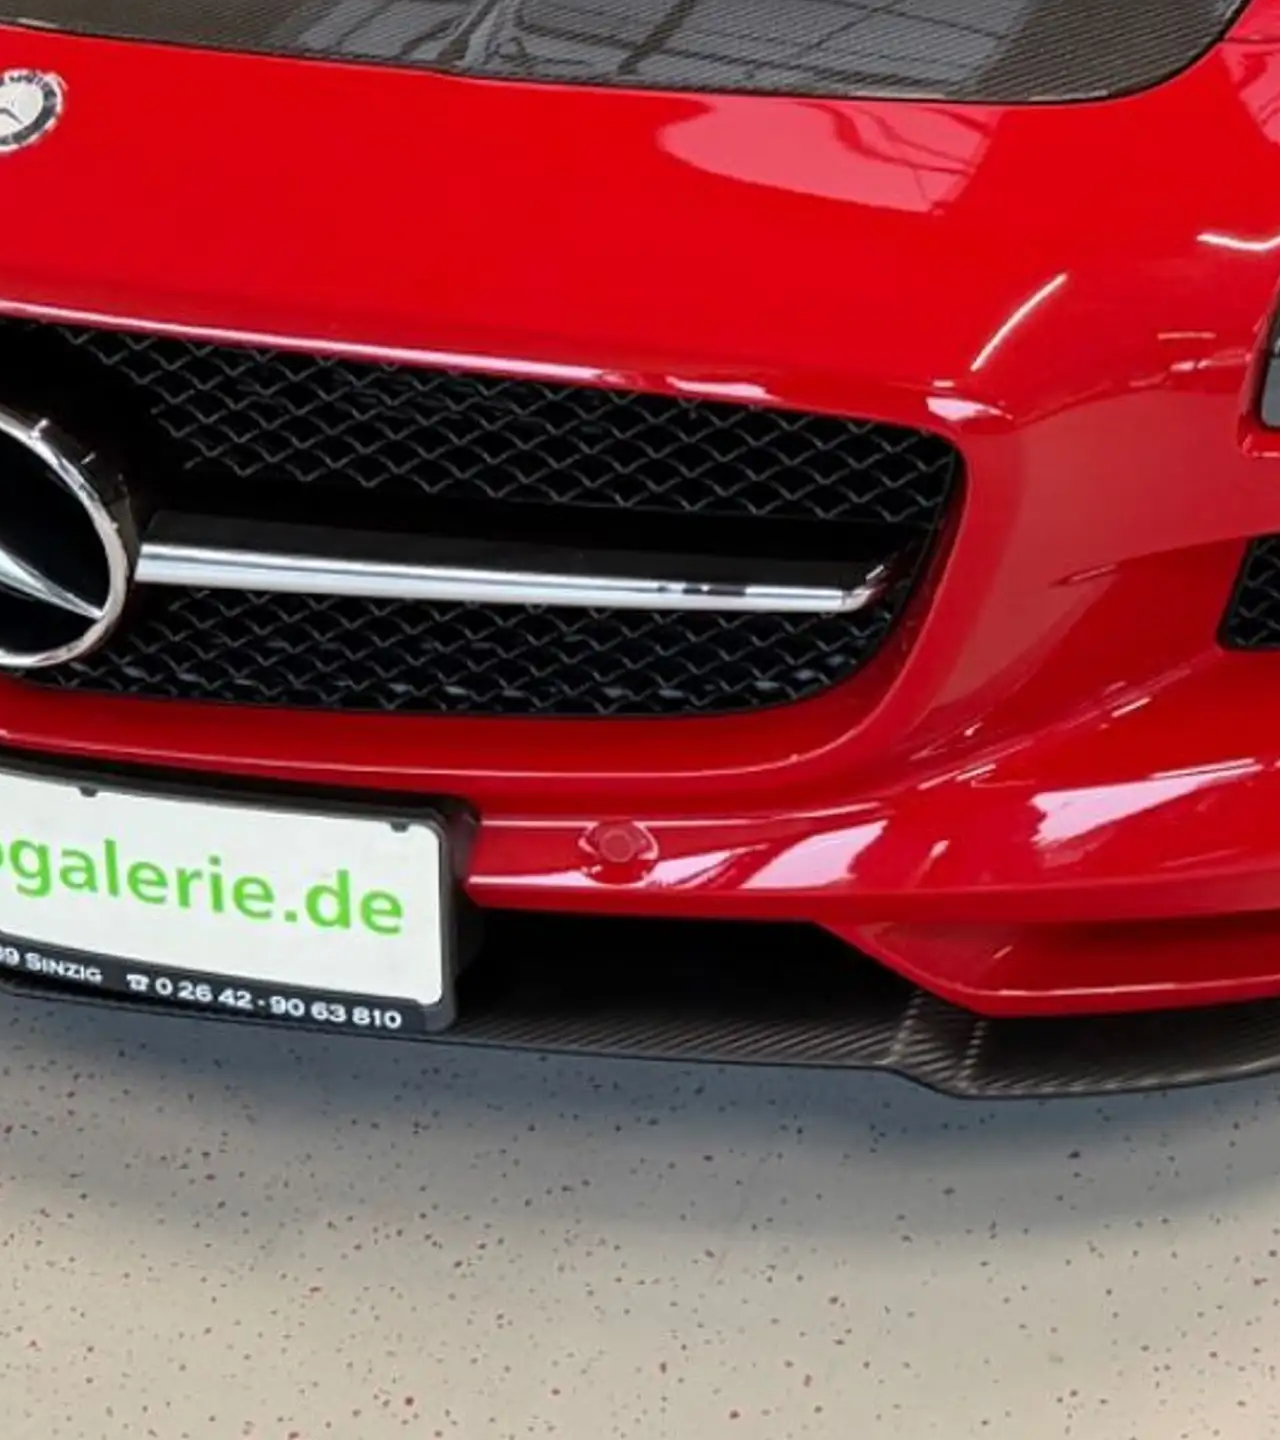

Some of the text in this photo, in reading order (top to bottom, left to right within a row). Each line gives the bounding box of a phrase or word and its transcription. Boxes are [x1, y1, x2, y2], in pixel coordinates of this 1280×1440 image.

[24, 951, 104, 985] SINZIG
[177, 981, 212, 1002] 26
[218, 987, 253, 1010] 42
[269, 995, 306, 1017] 90
[310, 1001, 347, 1023] 63
[351, 1005, 403, 1029] 810
